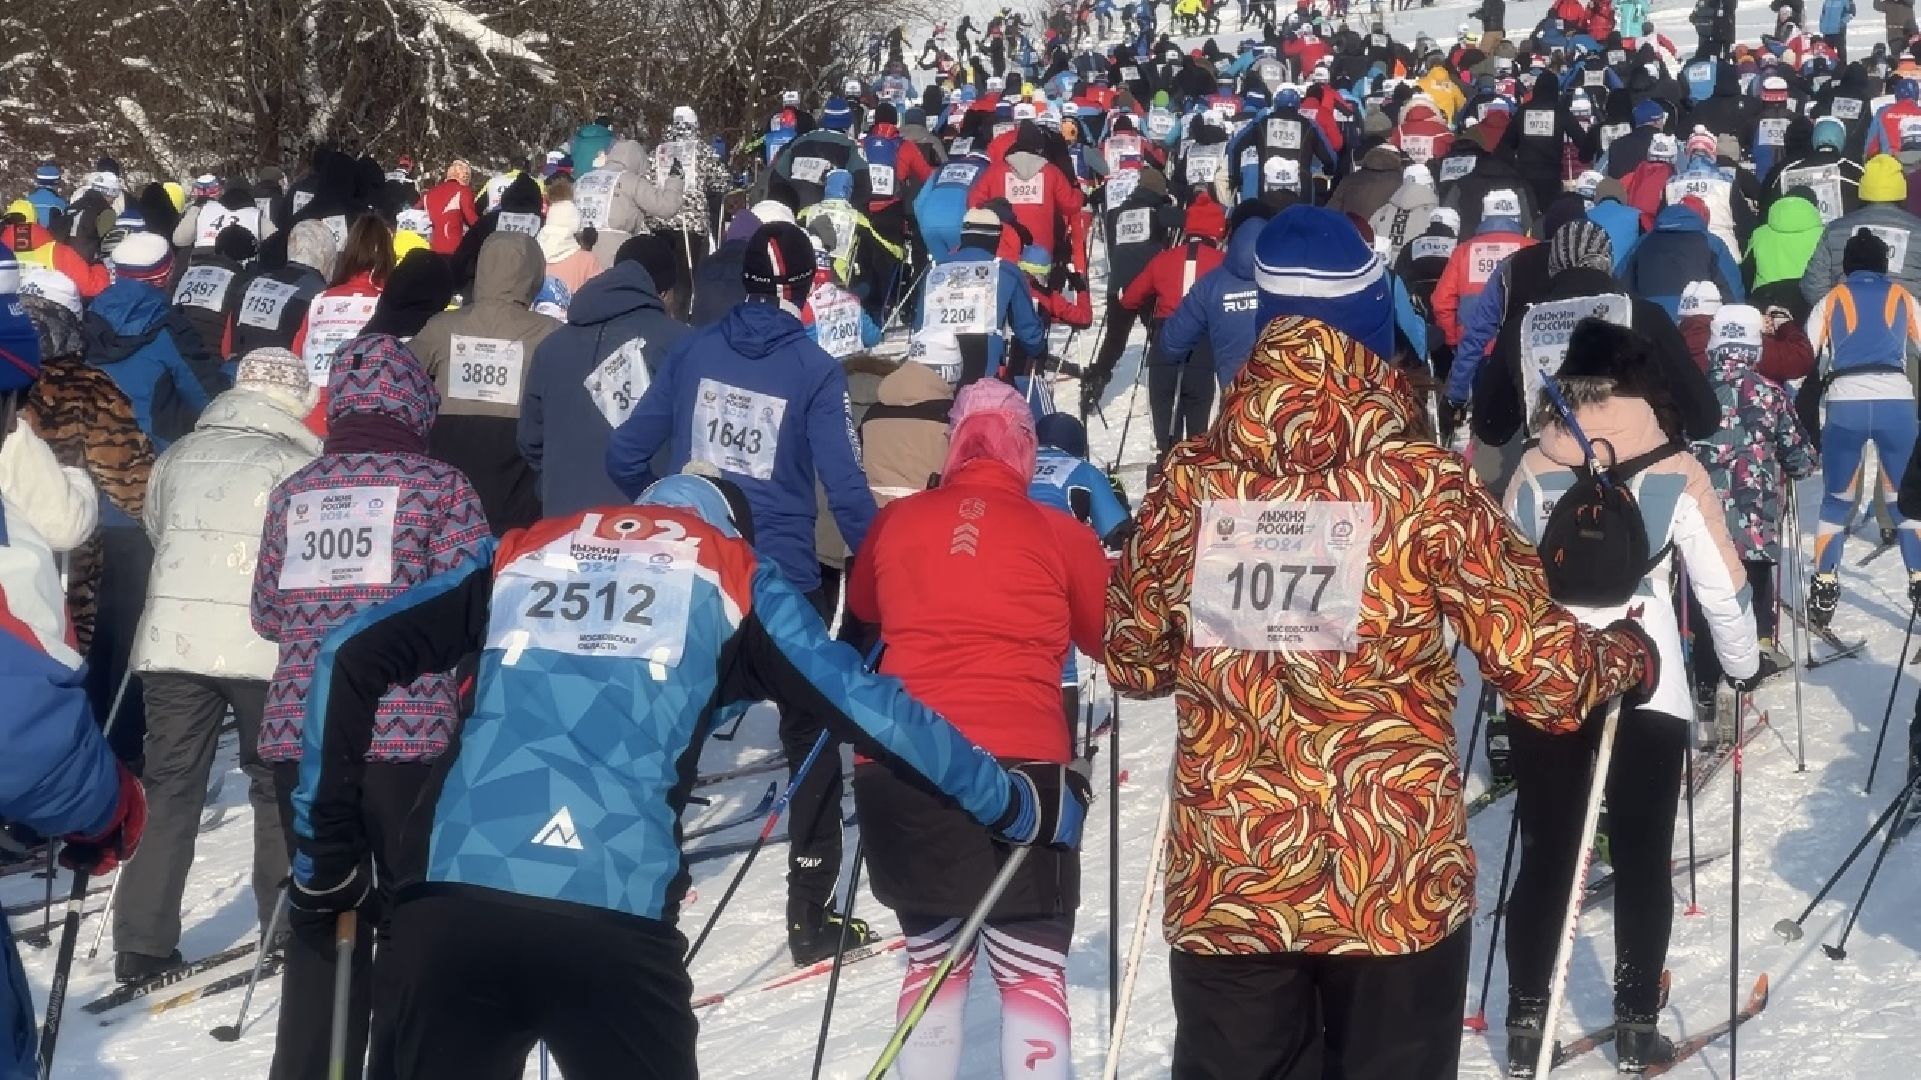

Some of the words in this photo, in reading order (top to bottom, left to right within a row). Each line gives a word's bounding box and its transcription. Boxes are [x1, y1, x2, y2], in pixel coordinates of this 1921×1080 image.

[1011, 185, 1037, 196] 9924
[940, 308, 976, 324] 2204
[462, 362, 508, 386] 3888
[707, 417, 762, 454] 1643
[1258, 510, 1307, 523] ЛЫЖНЯ
[1255, 522, 1304, 535] РОССИИ
[301, 526, 373, 561] 3005
[1253, 537, 1302, 551] 2024
[1227, 562, 1337, 612] 1077
[525, 580, 656, 626] 2512
